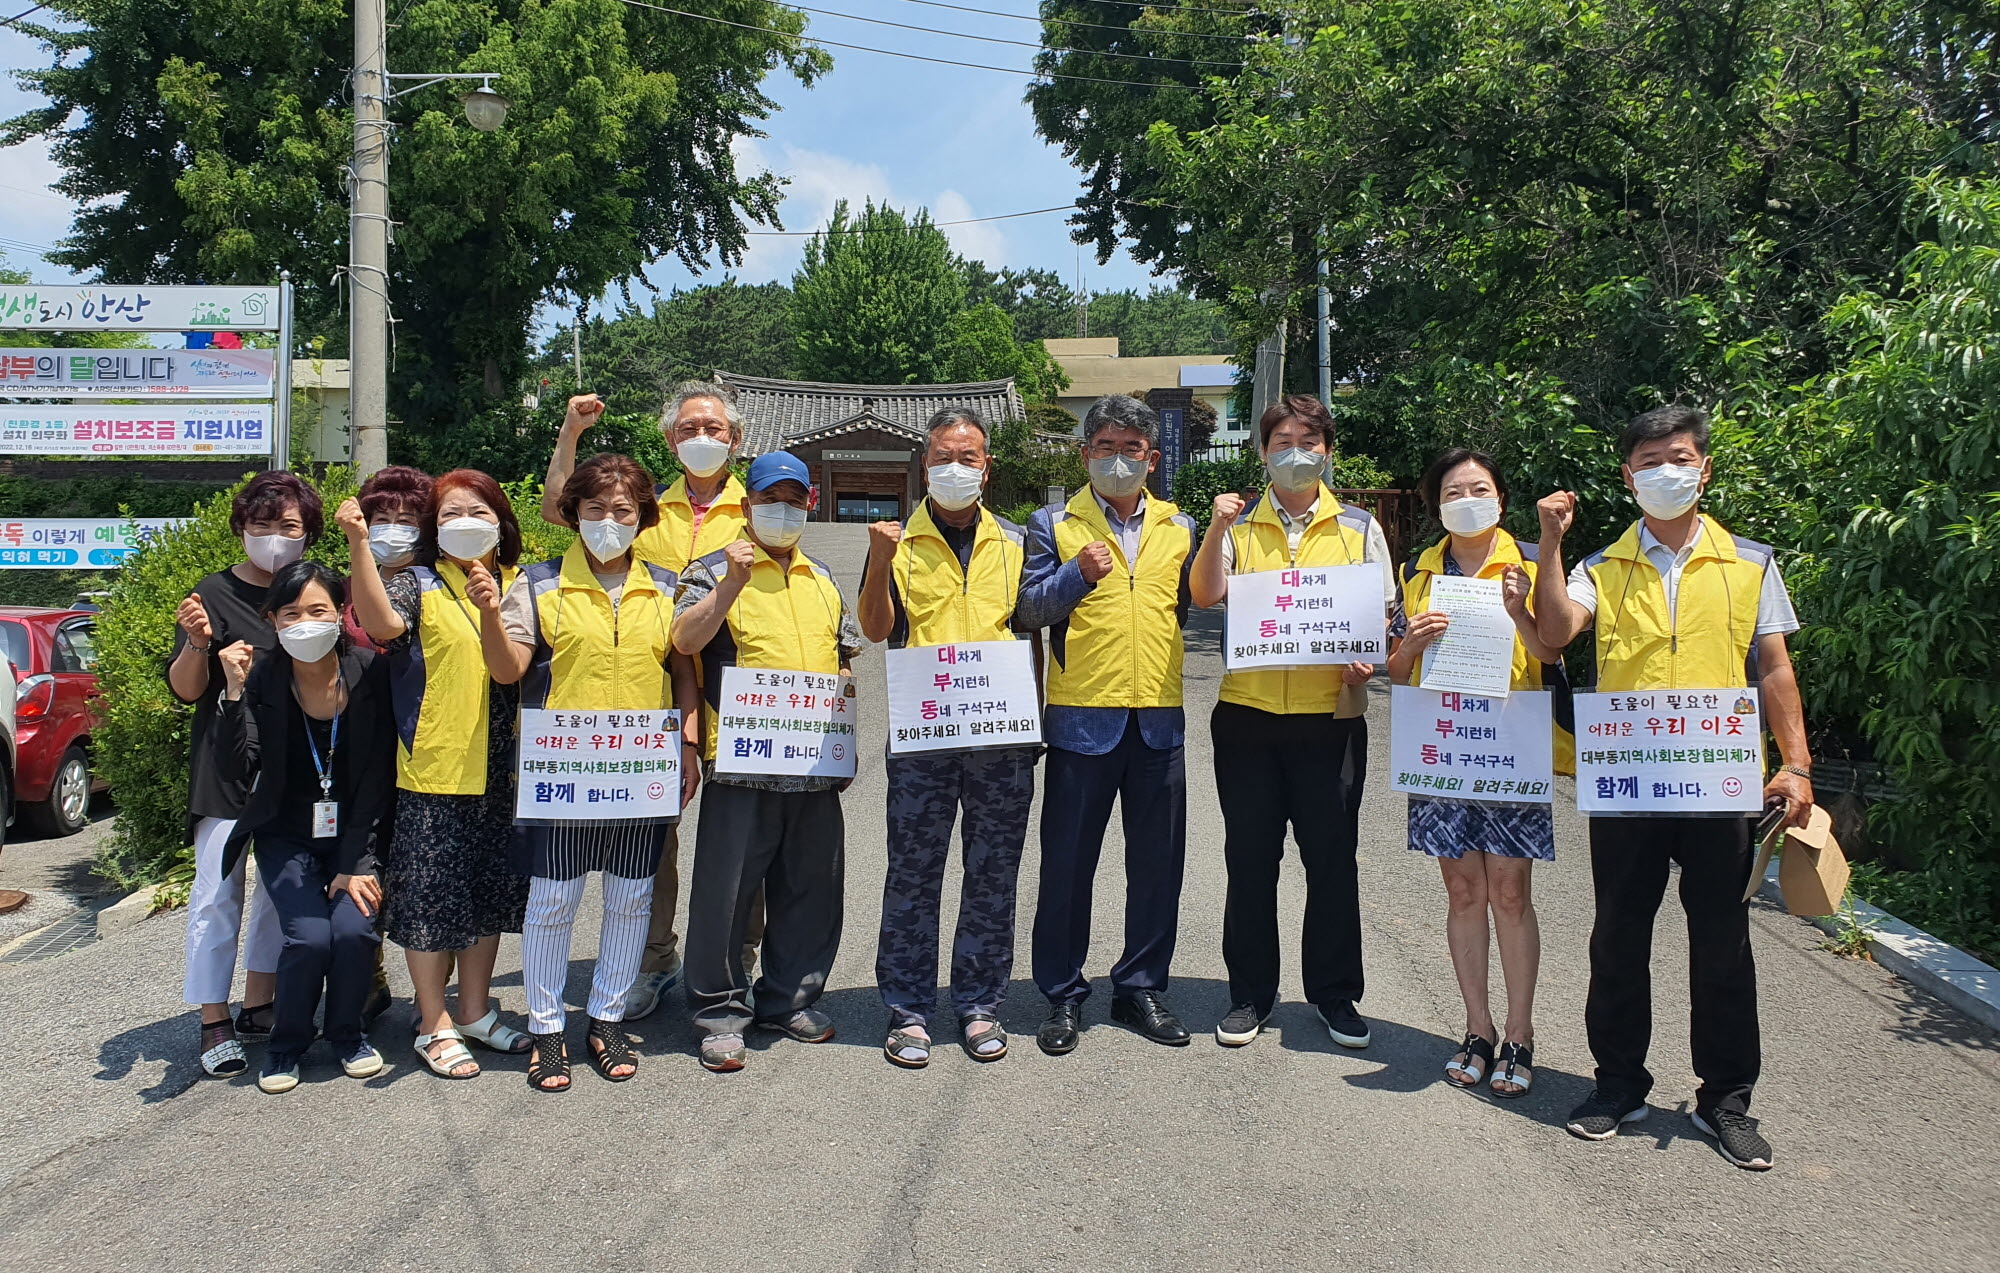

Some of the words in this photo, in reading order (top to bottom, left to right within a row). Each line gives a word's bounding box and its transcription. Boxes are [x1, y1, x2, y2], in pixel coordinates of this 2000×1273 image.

[82, 293, 150, 322] 안산
[70, 356, 174, 380] 달입니다
[3, 430, 26, 440] 설치
[31, 431, 67, 440] 의무화
[74, 420, 175, 441] 설치보조금
[184, 420, 262, 440] 지원사업
[1165, 413, 1173, 441] 단원구
[0, 523, 24, 547] 독
[32, 529, 86, 545] 이렇게
[37, 551, 66, 563] 먹기
[1282, 570, 1327, 587] 대차게
[1275, 595, 1333, 612] 부지런히
[1259, 619, 1291, 637] 동네
[1298, 621, 1350, 633] 구석구석
[938, 646, 982, 665] 대차게
[1234, 642, 1299, 658] 찾아주세요!
[1311, 641, 1380, 653] 알려주세요!
[753, 673, 795, 687] 도움이
[804, 675, 836, 691] 필요한
[934, 673, 990, 692] 부지런히
[736, 694, 778, 707] 어려운
[786, 694, 815, 709] 우리
[824, 697, 847, 712] 이웃
[920, 700, 951, 720] 동네
[958, 701, 1007, 715] 구석구석
[1609, 696, 1655, 712] 도움이
[1666, 694, 1718, 709] 필요한
[553, 714, 597, 728] 도움이
[608, 714, 651, 728] 필요한
[723, 716, 854, 735] 대부동지역사회보장협의체가
[897, 724, 960, 742] 찾아주세요!
[970, 719, 1034, 735] 알려주세요!
[1435, 719, 1496, 740] 부지런히
[1589, 722, 1634, 737] 어려운
[1644, 716, 1685, 736] 우리
[1701, 716, 1745, 736] 이웃
[536, 736, 580, 750] 어려운
[588, 734, 622, 750] 우리
[634, 733, 667, 750] 이웃
[734, 737, 773, 758] 함께
[784, 745, 822, 759] 합니다.
[1421, 744, 1452, 765] 동네
[1459, 755, 1514, 769] 구석구석
[1581, 748, 1756, 764] 대부동지역사회보장협의체가
[523, 759, 677, 774] 대부동지역사회보장협의체가
[535, 782, 575, 803] 함께
[588, 788, 634, 802] 합니다.
[1398, 772, 1463, 791] 찾아주세요!
[1473, 779, 1548, 796] 알려주세요!
[1595, 776, 1639, 799] 함께
[1652, 783, 1707, 798] 합니다.
